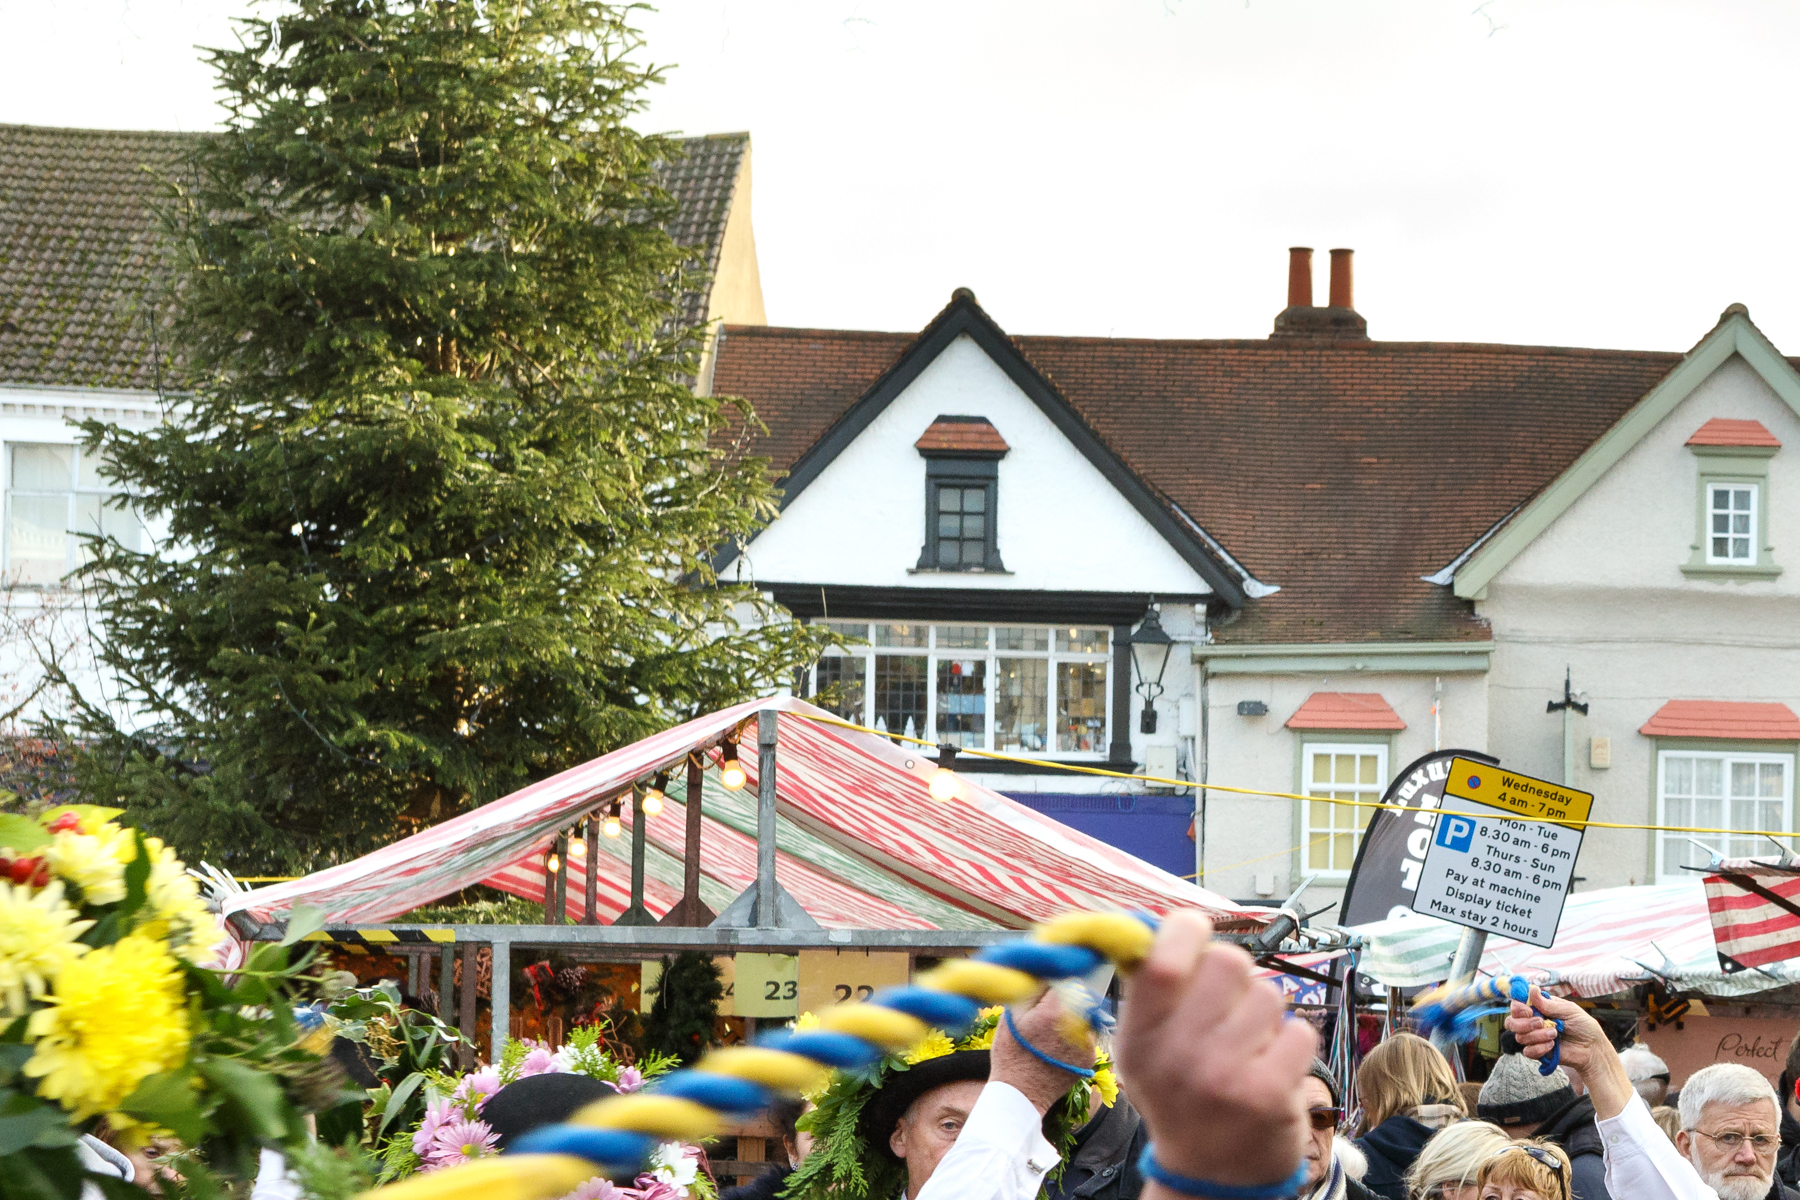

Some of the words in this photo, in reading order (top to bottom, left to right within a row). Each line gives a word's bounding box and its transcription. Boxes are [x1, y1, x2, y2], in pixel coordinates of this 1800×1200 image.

[1498, 792, 1507, 802] 4
[1510, 798, 1528, 809] am
[1538, 803, 1546, 813] 7
[1546, 807, 1566, 819] pm
[1502, 776, 1573, 807] Wednesday
[1445, 818, 1470, 845] P
[1479, 826, 1510, 843] 8.30
[1512, 837, 1531, 849] am
[1541, 843, 1549, 854] 6
[1550, 848, 1571, 860] pm
[1500, 819, 1527, 832] Mon
[1537, 826, 1558, 841] Tue
[1470, 857, 1502, 874] 8.30
[1504, 868, 1522, 880] am
[1532, 874, 1541, 885] 6
[1542, 879, 1562, 892] pm
[1486, 845, 1521, 864] Thurs
[1530, 858, 1556, 874] Sun
[1445, 868, 1469, 885] Pay
[1472, 875, 1485, 888] at
[1489, 881, 1541, 904] machine
[1445, 886, 1492, 909] Display
[1496, 899, 1532, 919] ticket
[1430, 899, 1456, 916] Max
[1460, 909, 1487, 925] stay
[1490, 916, 1500, 926] 2
[1503, 919, 1539, 938] hours
[764, 981, 798, 1001] 23
[1714, 1032, 1784, 1062] Perfect
